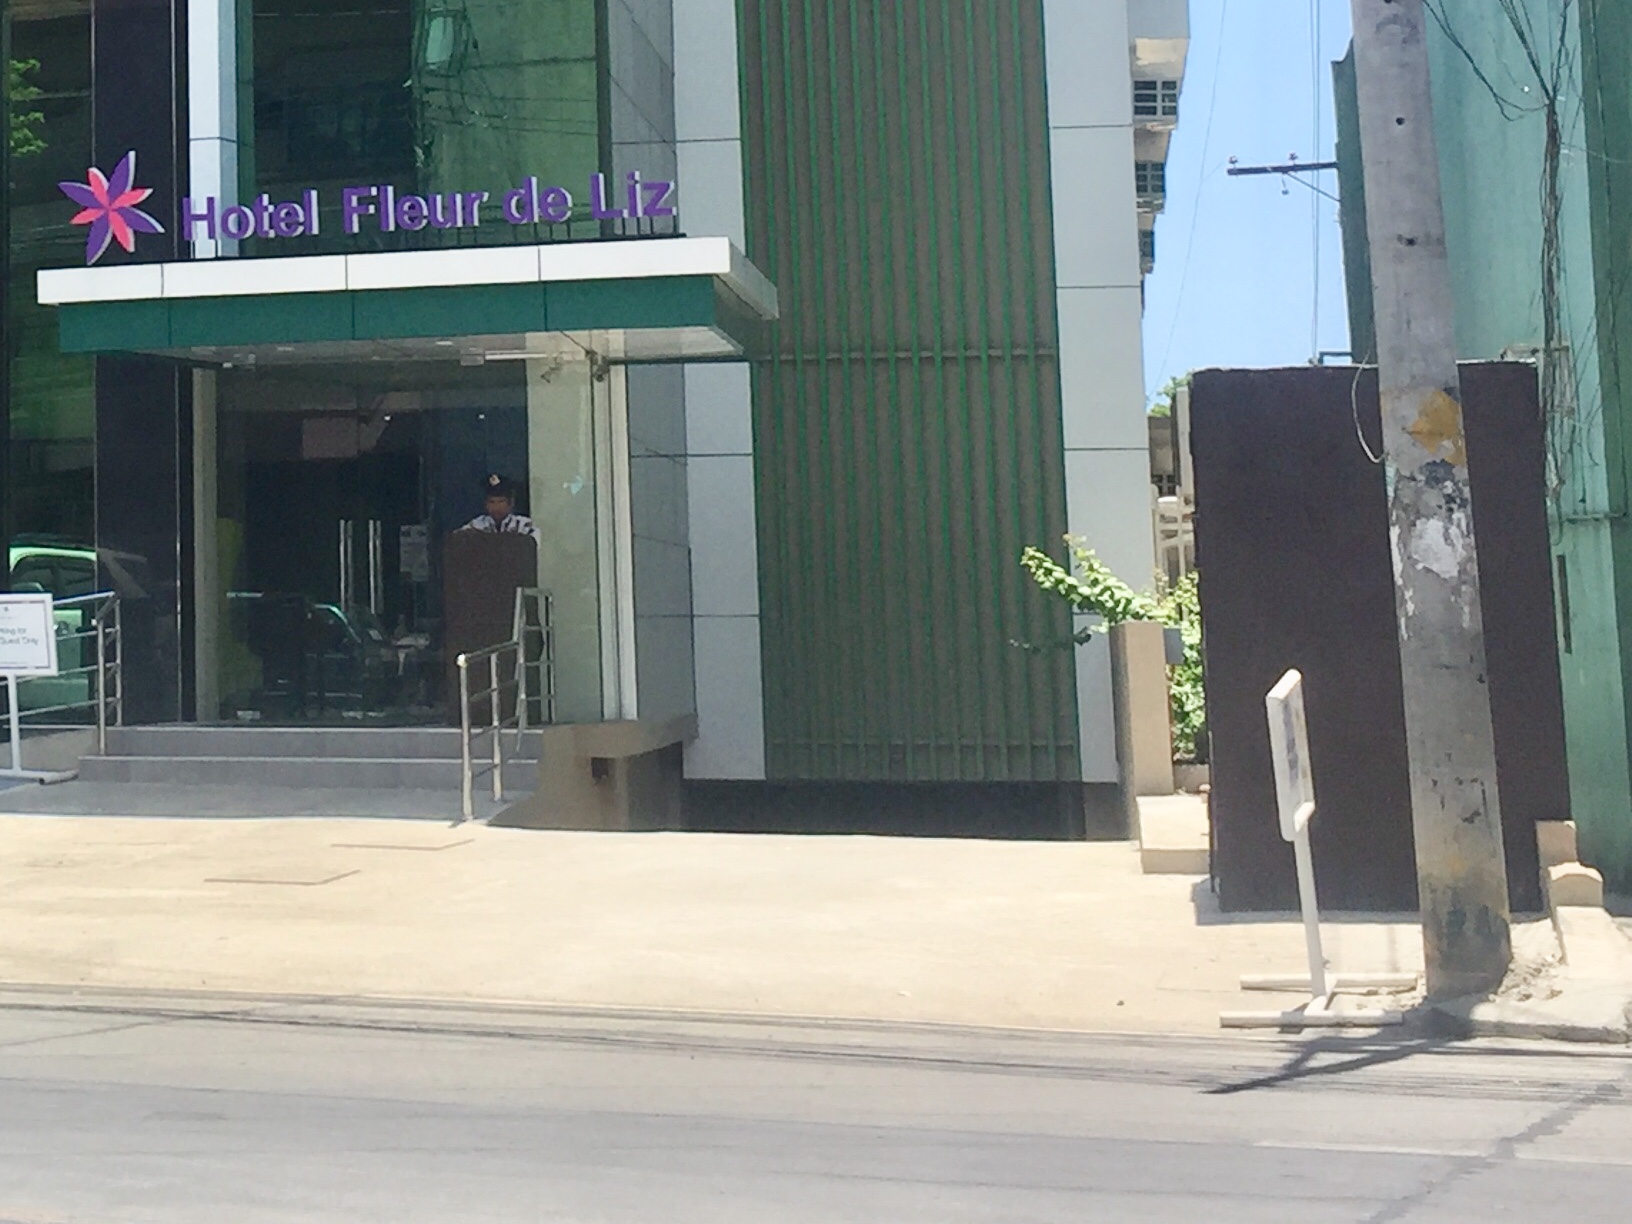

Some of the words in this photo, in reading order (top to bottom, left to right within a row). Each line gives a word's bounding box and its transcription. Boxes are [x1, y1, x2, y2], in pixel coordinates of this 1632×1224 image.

[182, 188, 320, 241] Hotel
[343, 185, 489, 235] Fleur
[503, 176, 573, 226] de
[590, 170, 678, 220] Liz
